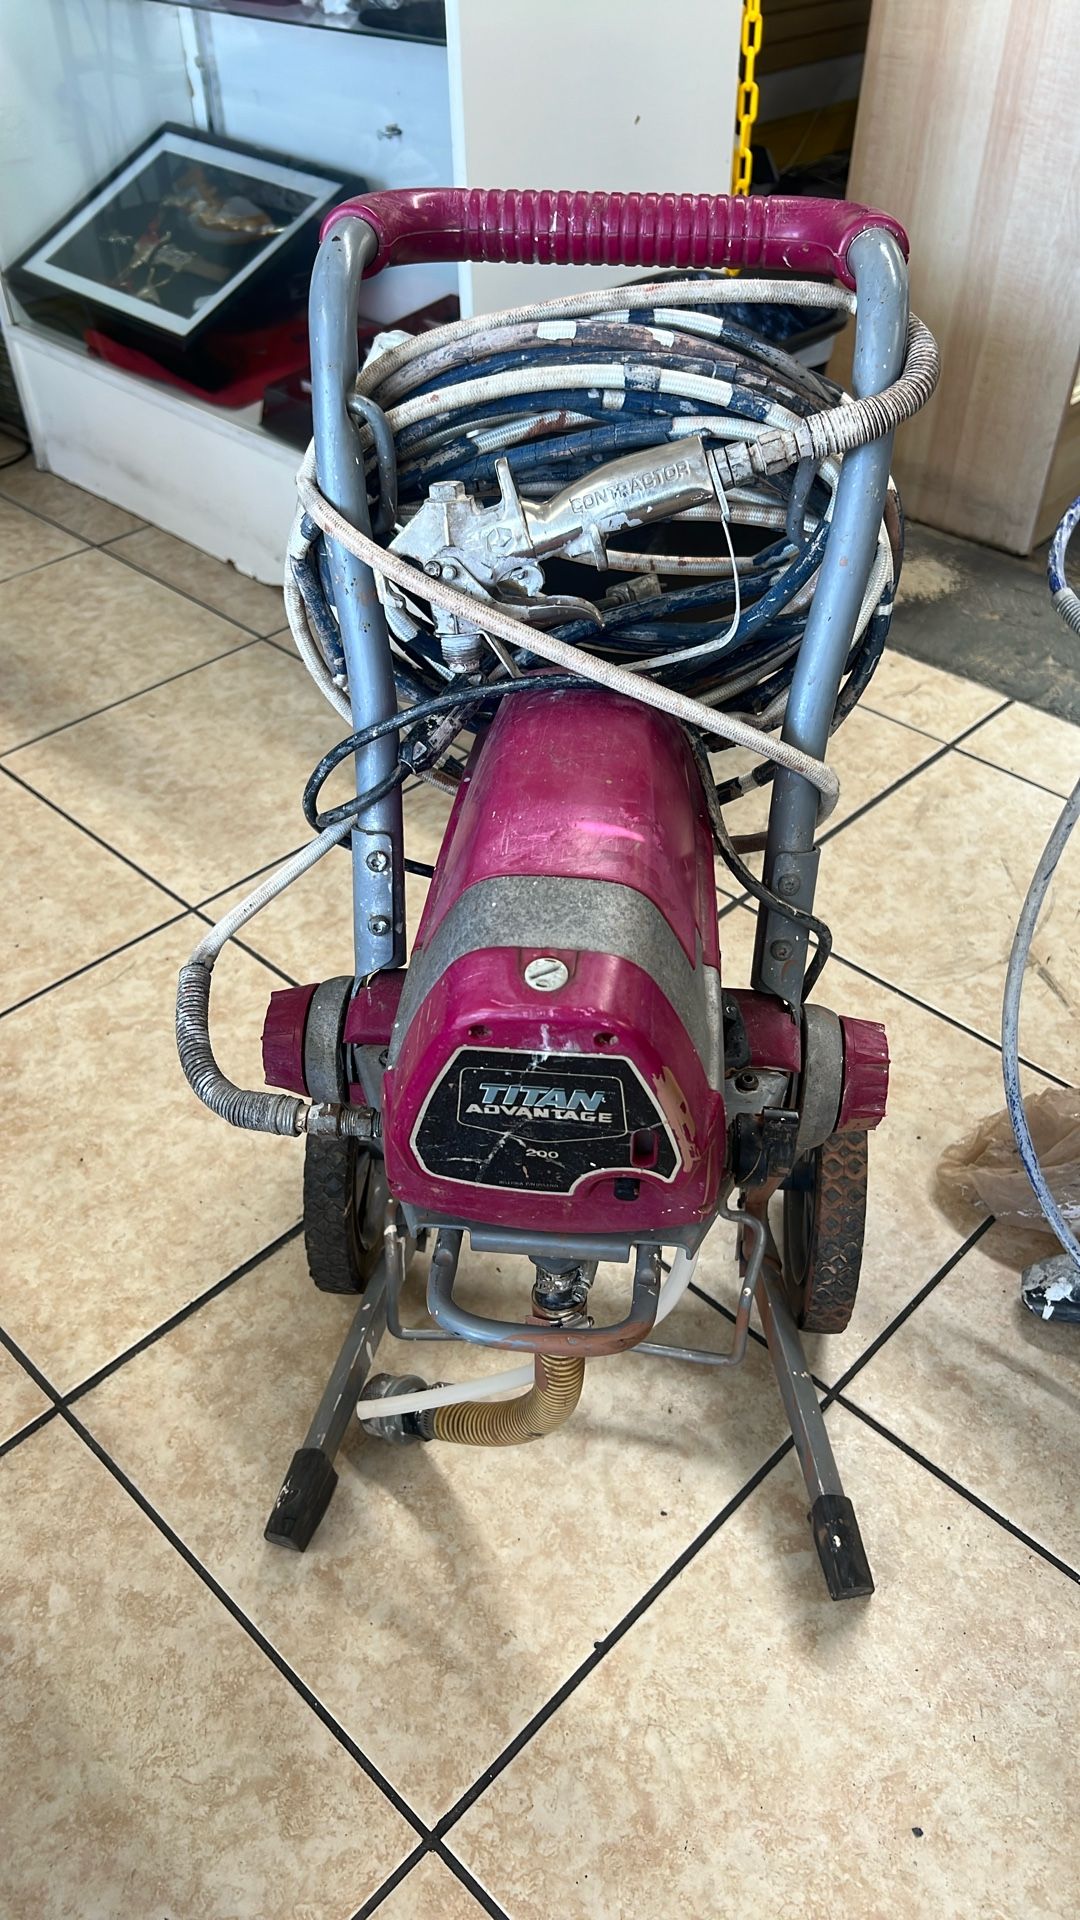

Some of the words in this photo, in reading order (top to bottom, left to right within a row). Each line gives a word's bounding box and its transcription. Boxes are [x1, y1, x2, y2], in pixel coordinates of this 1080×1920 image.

[569, 460, 691, 514] CONTRACTOR
[479, 1083, 605, 1111] TITAN
[465, 1103, 613, 1124] ADVANTAGE
[525, 1148, 559, 1160] 200
